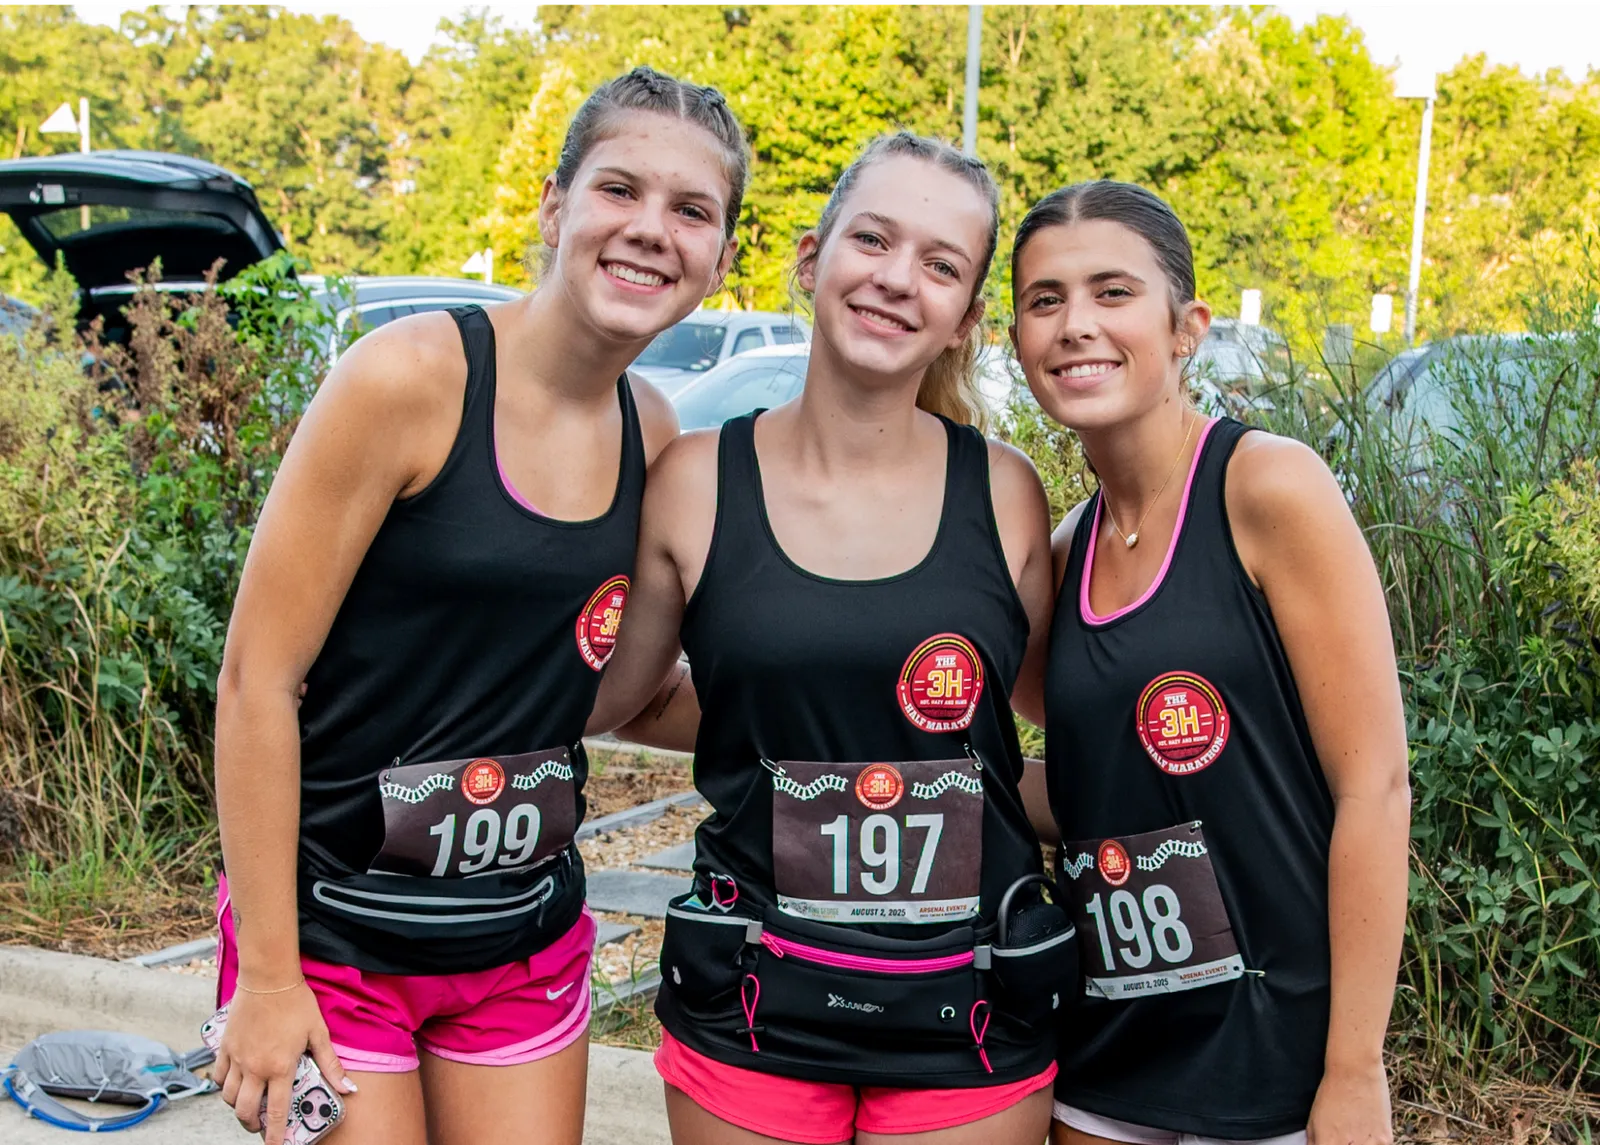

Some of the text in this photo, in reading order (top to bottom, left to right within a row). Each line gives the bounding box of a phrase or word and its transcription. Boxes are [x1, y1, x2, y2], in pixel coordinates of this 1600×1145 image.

[600, 608, 622, 636] 3H
[580, 637, 596, 662] HALF
[935, 655, 956, 667] THE
[926, 669, 963, 698] 3H
[1164, 693, 1188, 705] THE
[904, 701, 976, 731] HALF MARATHON
[1159, 705, 1201, 738] 3H
[1147, 736, 1225, 773] HALF MARATHON
[475, 774, 493, 789] 3H
[870, 779, 890, 794] 3H
[429, 803, 541, 877] 199
[820, 813, 944, 895] 197
[850, 908, 906, 917] AUGUST 2, 2025
[1085, 884, 1194, 971] 198
[1123, 982, 1145, 992] AUGUST
[1146, 981, 1153, 990] 2,
[1153, 978, 1169, 988] 2025
[1180, 971, 1204, 980] ARSENAL
[1205, 965, 1228, 975] EVENTS
